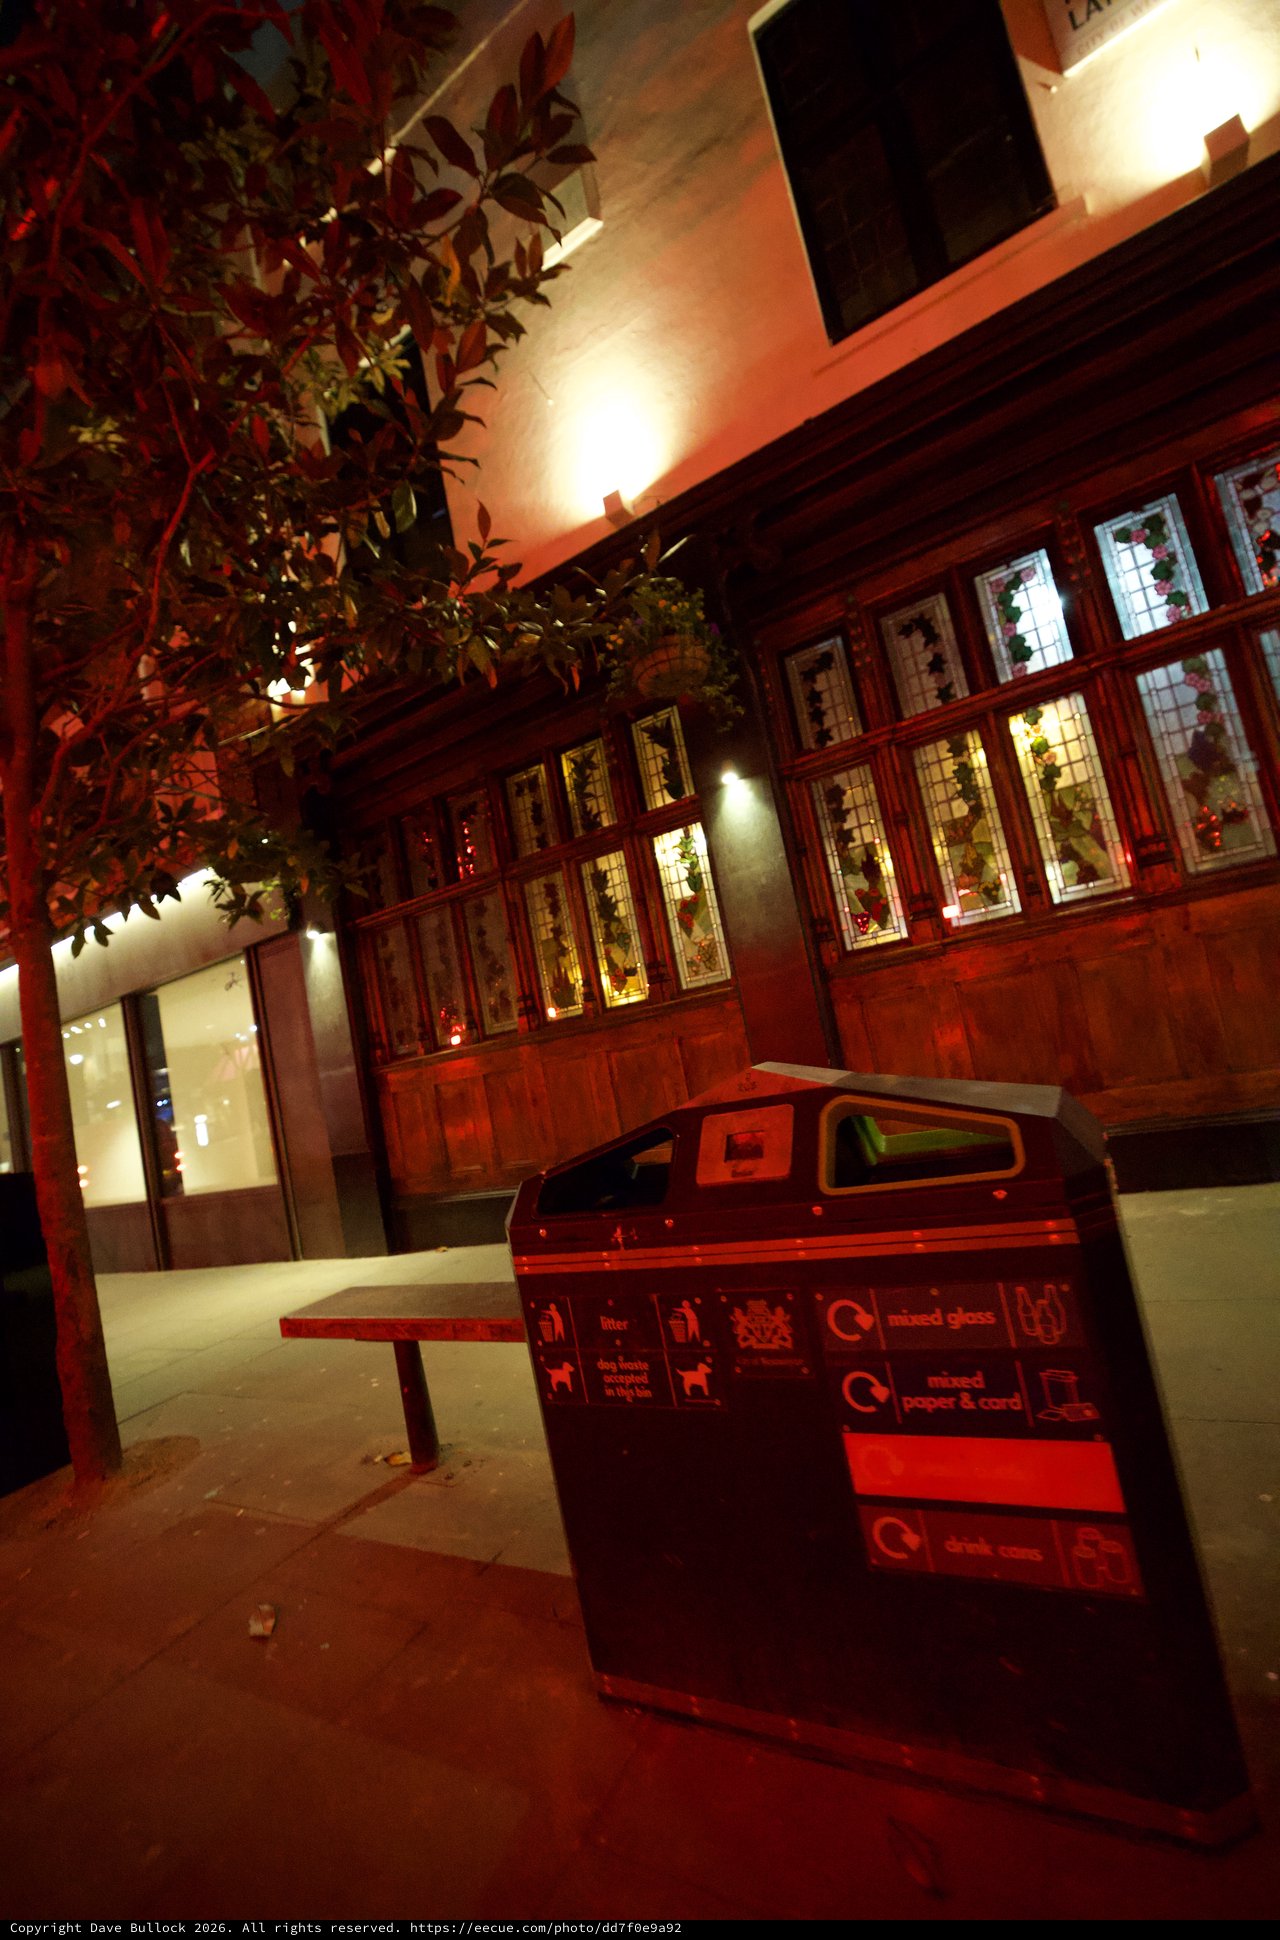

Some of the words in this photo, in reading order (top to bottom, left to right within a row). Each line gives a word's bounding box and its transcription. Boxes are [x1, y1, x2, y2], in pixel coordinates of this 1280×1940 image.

[1068, 0, 1112, 31] LA
[600, 1315, 629, 1331] litter
[888, 1308, 944, 1327] mixed
[946, 1306, 997, 1330] glass
[597, 1358, 617, 1373] dog
[618, 1360, 649, 1371] waste
[603, 1372, 649, 1386] accepted
[927, 1370, 985, 1389] mixed
[604, 1385, 615, 1397] in
[616, 1386, 635, 1397] this
[635, 1386, 653, 1398] bin
[902, 1396, 956, 1414] paper
[958, 1391, 977, 1410] &
[978, 1391, 1024, 1411] card
[944, 1535, 994, 1557] drink
[998, 1545, 1044, 1562] cans
